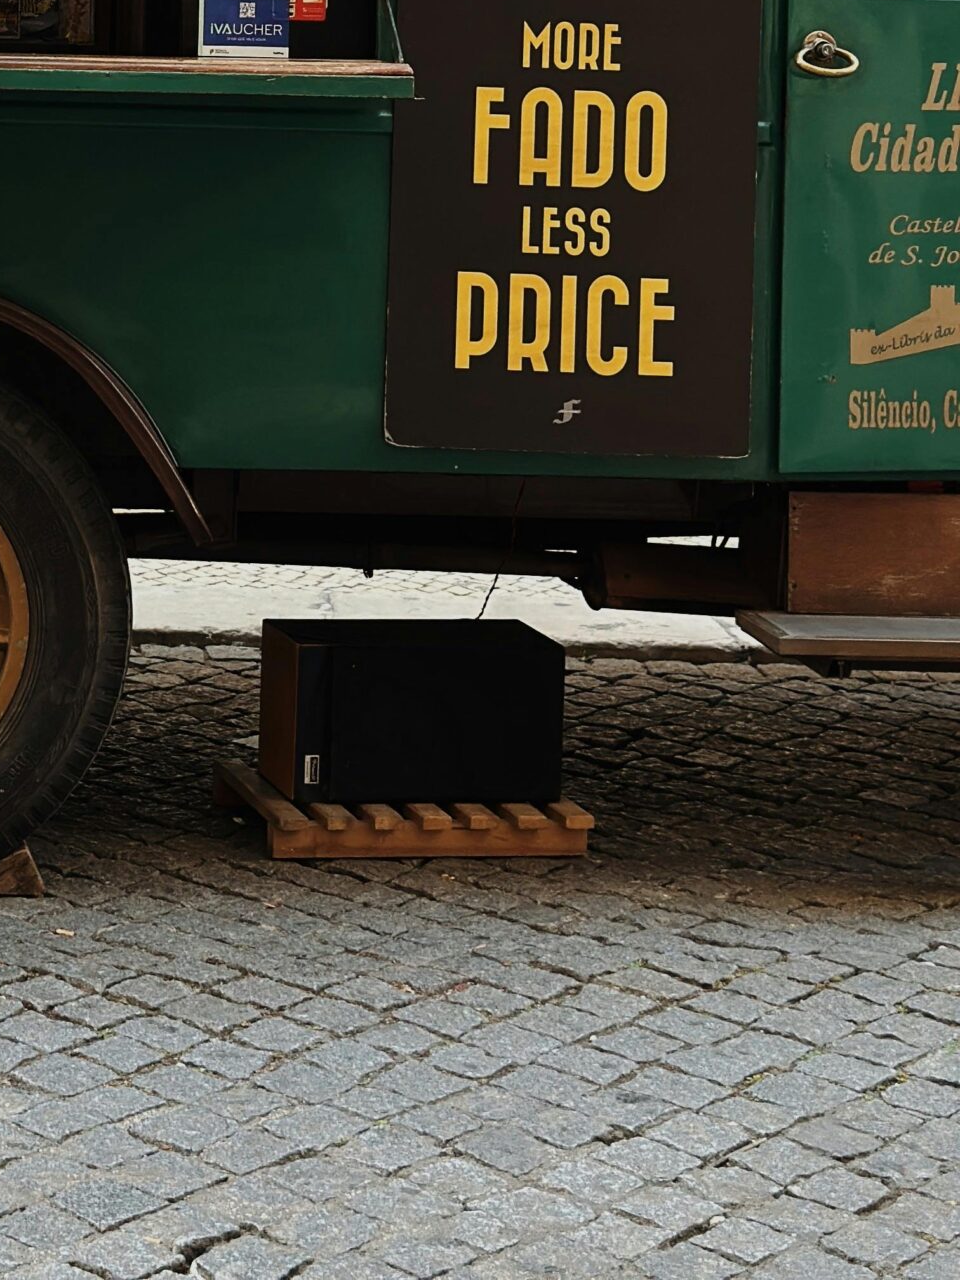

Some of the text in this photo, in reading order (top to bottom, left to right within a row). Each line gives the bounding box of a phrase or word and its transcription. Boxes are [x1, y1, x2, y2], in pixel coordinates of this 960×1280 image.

[522, 20, 622, 71] MORE
[473, 86, 668, 192] FADO
[521, 206, 611, 257] LESS
[868, 242, 896, 264] de
[900, 245, 923, 266] S.
[454, 271, 675, 377] PRICE
[934, 325, 956, 340] da
[848, 387, 936, 434] Silêncio,
